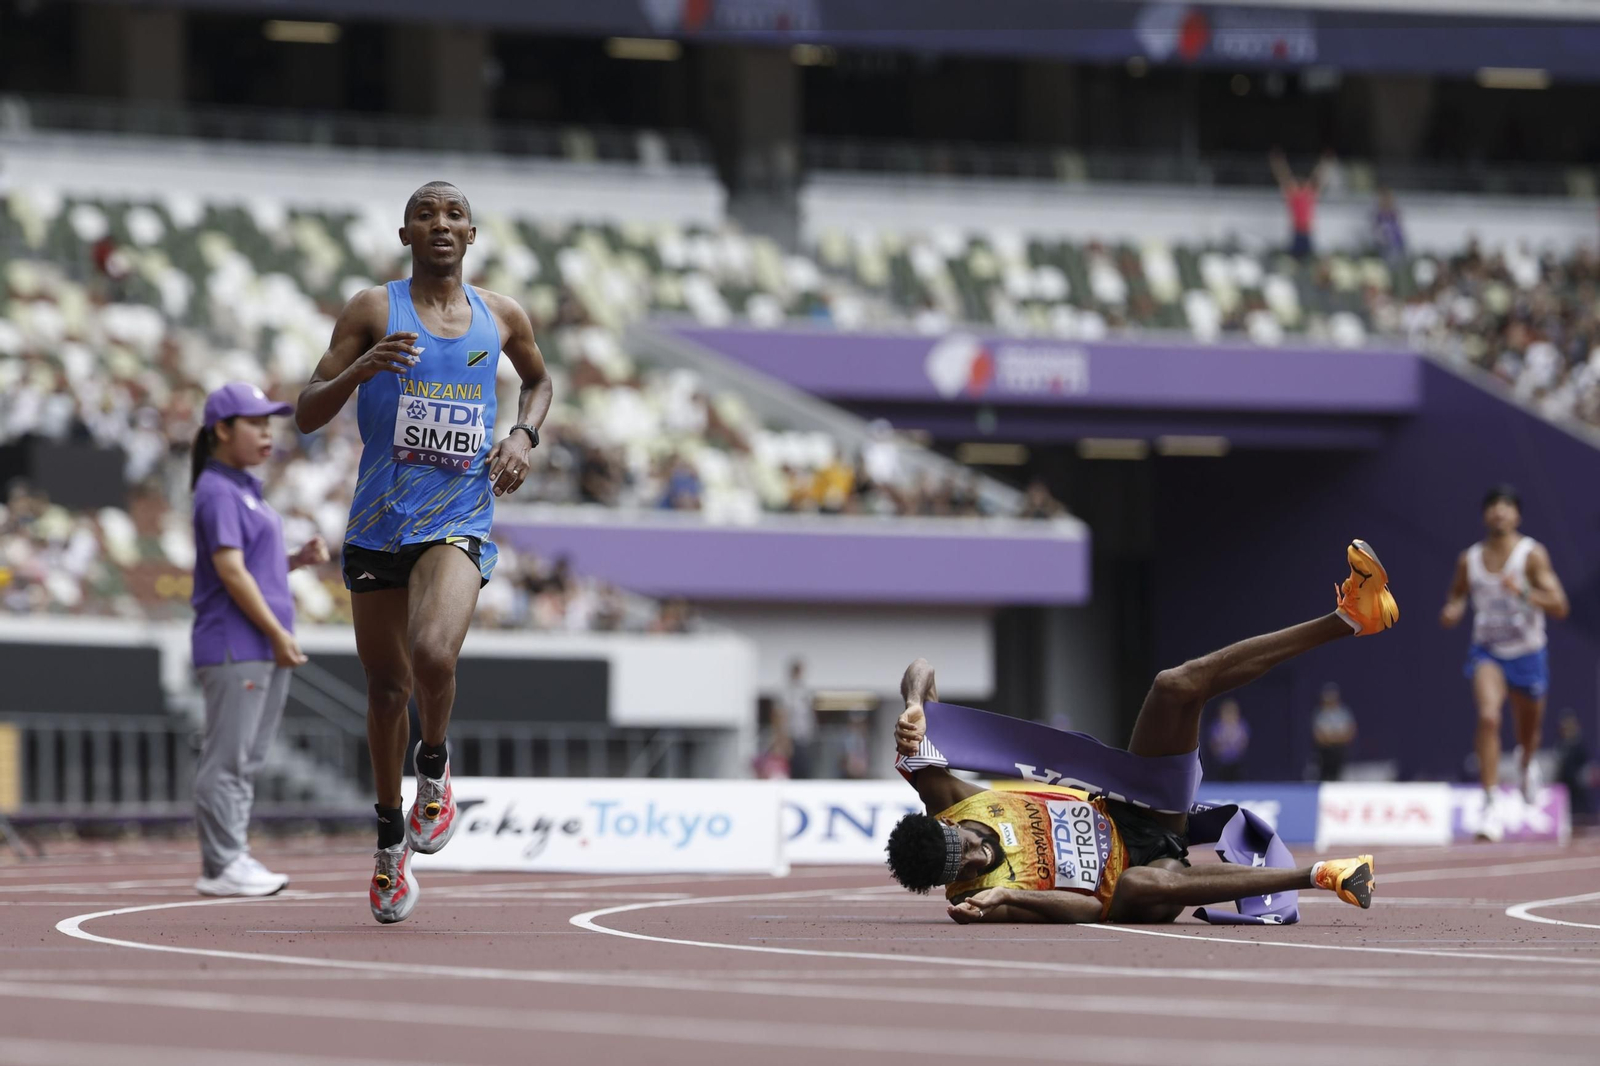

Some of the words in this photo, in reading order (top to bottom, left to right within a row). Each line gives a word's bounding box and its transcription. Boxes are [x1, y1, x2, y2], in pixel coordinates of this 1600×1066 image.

[399, 377, 482, 400] TANZANIA
[403, 425, 482, 454] SIMBU
[587, 799, 733, 850] Tokyo
[1024, 800, 1050, 880] GERMANY
[1050, 807, 1074, 860] TDK
[1070, 806, 1099, 884] PETROS
